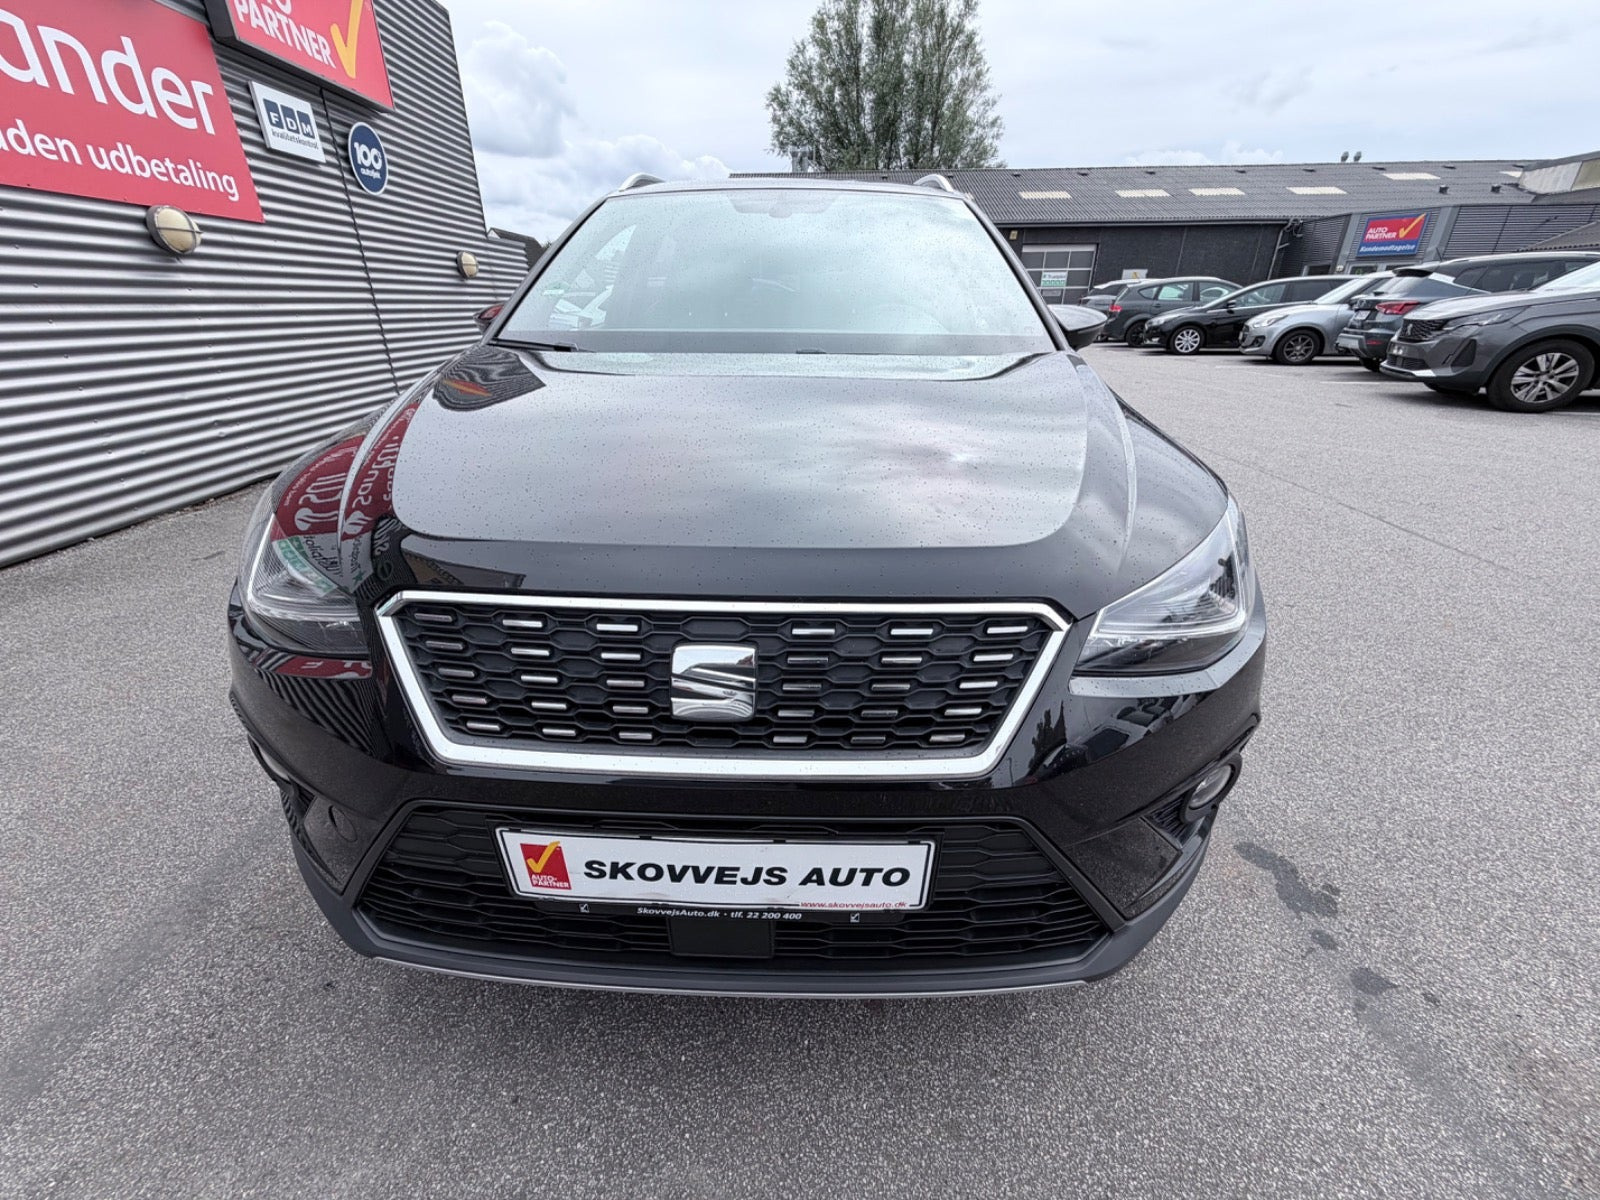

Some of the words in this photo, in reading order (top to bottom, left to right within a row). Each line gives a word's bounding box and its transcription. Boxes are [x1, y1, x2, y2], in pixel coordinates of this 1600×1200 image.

[234, 0, 337, 70] PARTNER
[268, 111, 314, 138] FDM
[86, 140, 240, 202] udbetaling
[1365, 232, 1397, 240] PARTNER
[1367, 226, 1388, 234] AUTO
[584, 859, 787, 887] SKOVVEJS
[798, 866, 910, 888] AUTO
[532, 881, 569, 889] PARTNER
[636, 907, 720, 918] SkovvejsAuto.dk
[761, 912, 781, 920] 200
[782, 912, 802, 920] 400
